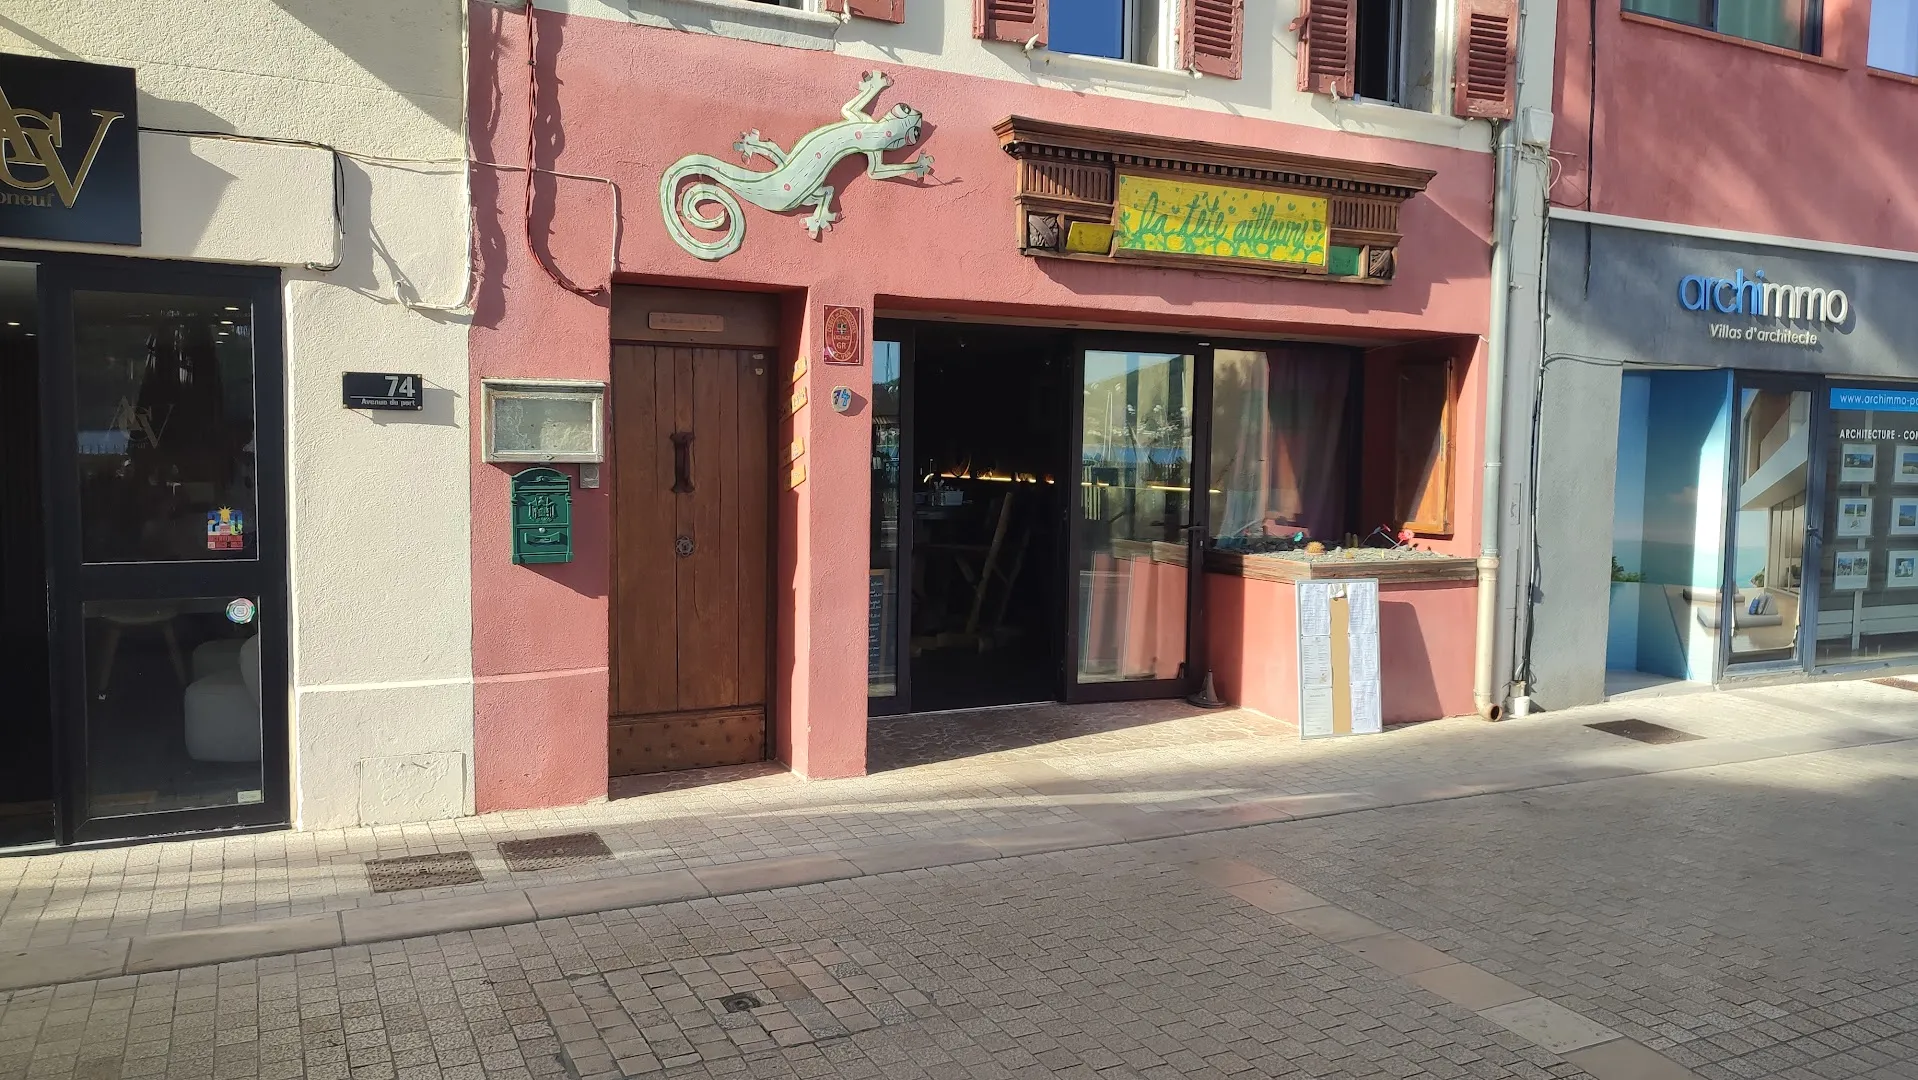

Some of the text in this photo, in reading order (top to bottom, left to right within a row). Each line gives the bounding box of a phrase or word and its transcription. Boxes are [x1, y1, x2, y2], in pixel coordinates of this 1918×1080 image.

[1139, 192, 1168, 236] la
[1678, 268, 1849, 324] archimmo
[1708, 322, 1818, 346] Villas d'architecte
[836, 342, 847, 350] GR
[385, 375, 415, 398] 74
[361, 398, 416, 407] Avenue du port
[1839, 428, 1896, 440] ARCHITECTURE
